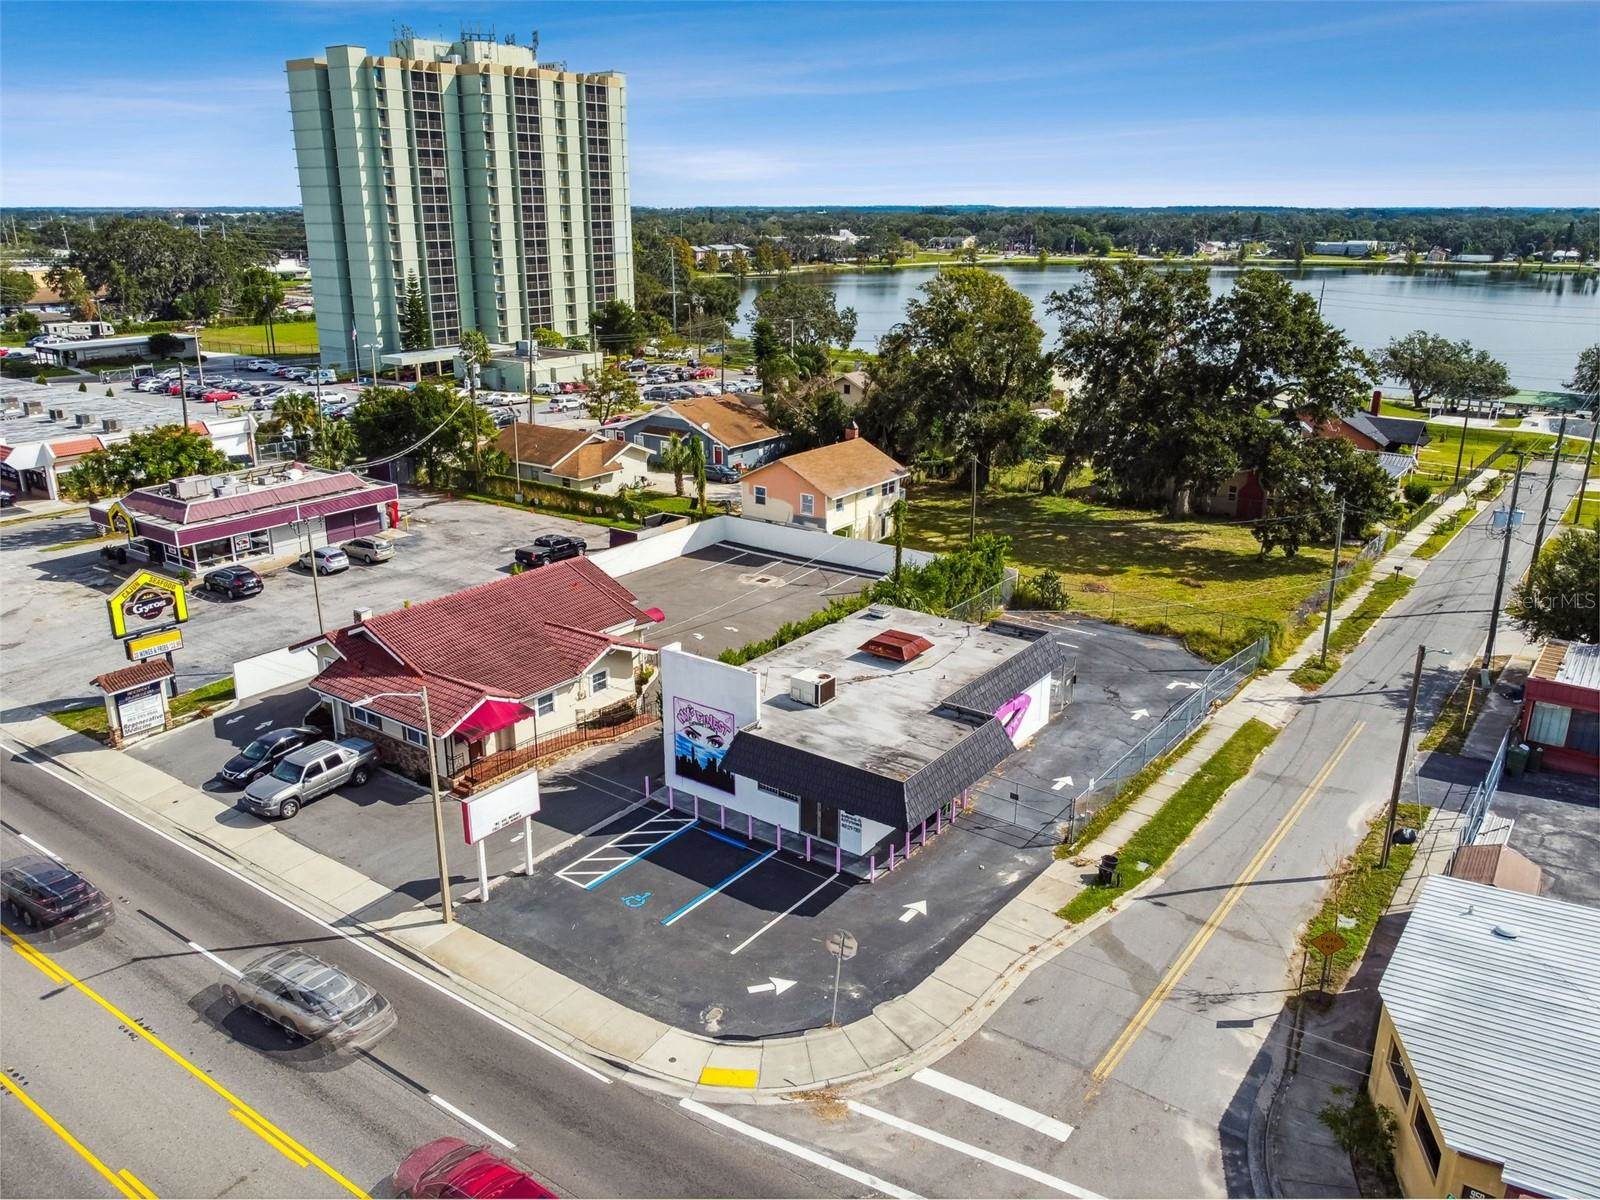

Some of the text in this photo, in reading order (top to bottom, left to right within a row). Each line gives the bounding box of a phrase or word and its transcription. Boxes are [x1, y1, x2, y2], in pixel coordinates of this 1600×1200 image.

[122, 576, 177, 599] CAJUN SEAFOOD
[132, 598, 167, 614] Gyros
[123, 714, 164, 730] Regenerative
[124, 723, 153, 735] Medicine
[695, 710, 732, 737] FINEST
